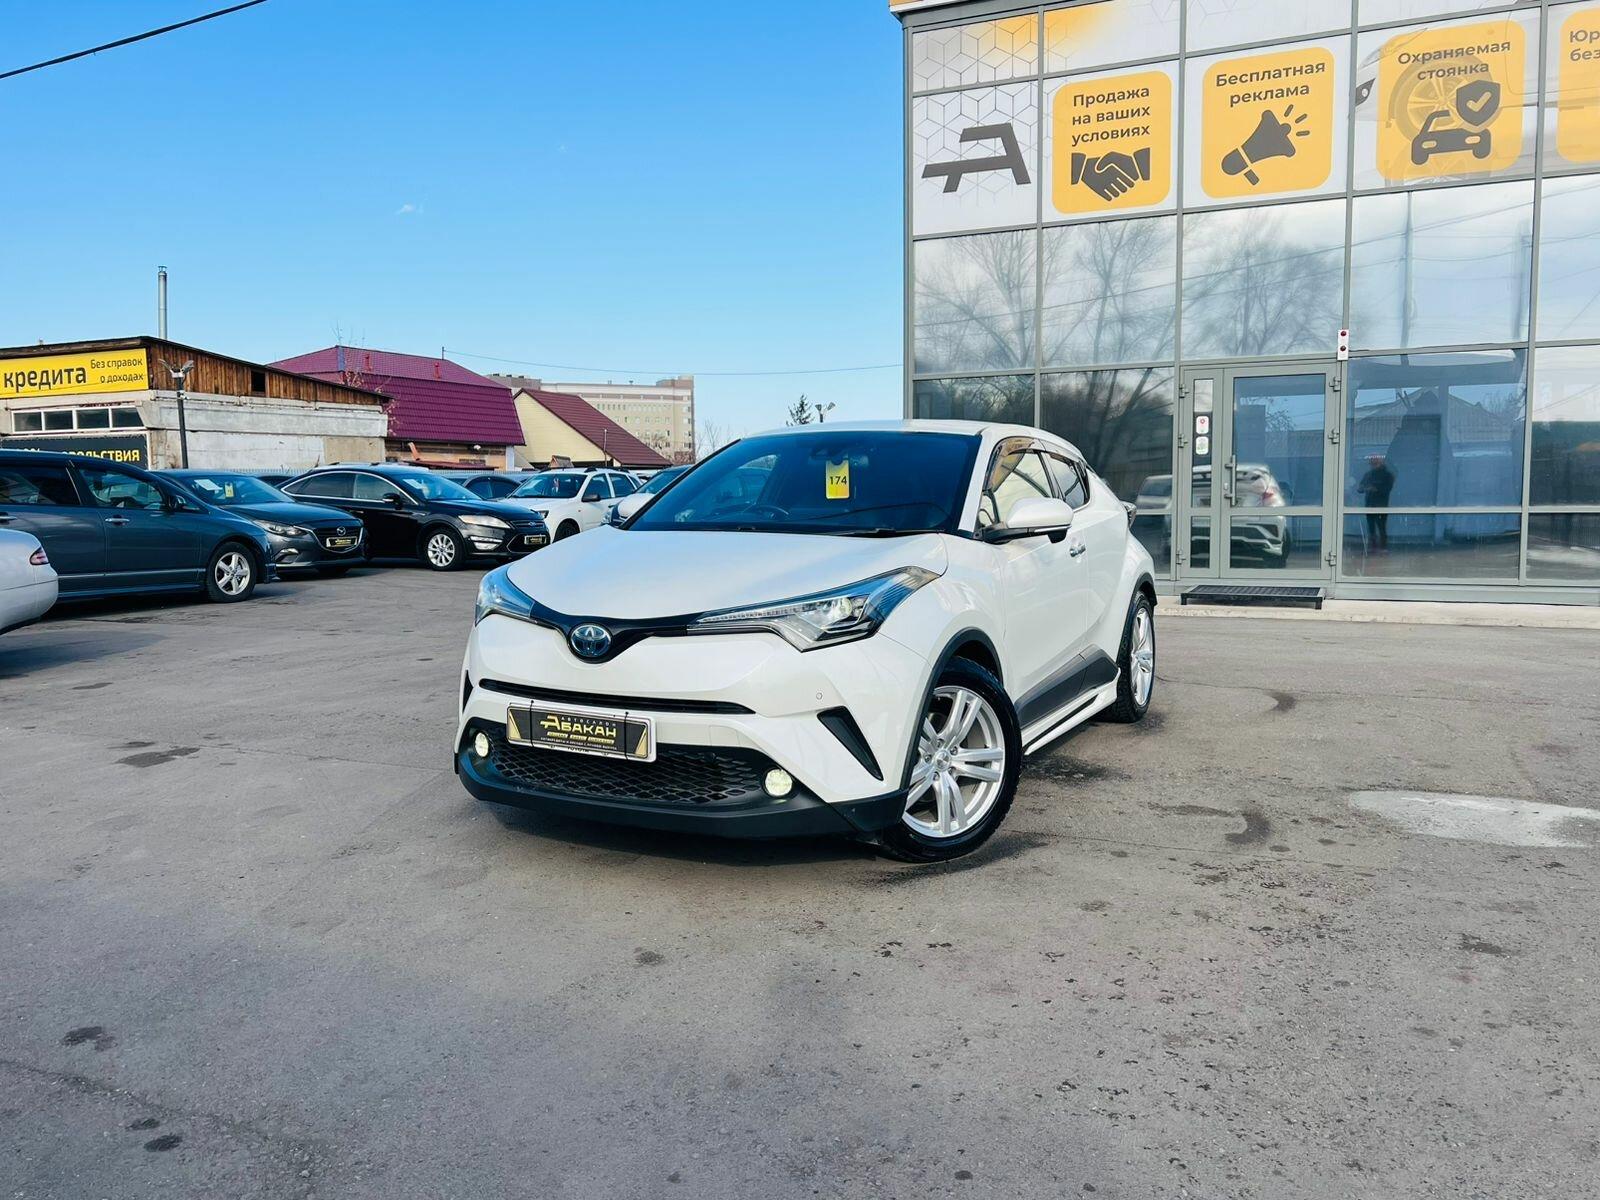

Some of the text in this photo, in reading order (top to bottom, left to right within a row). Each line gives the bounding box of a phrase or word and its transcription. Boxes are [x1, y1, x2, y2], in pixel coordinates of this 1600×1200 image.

[1569, 29, 1600, 44] Юр
[1397, 41, 1511, 65] Охраняемая
[1569, 48, 1600, 62] без
[1215, 62, 1326, 87] Бесплатная
[1417, 63, 1489, 81] стоянка
[1073, 87, 1150, 108] Продажа
[1230, 84, 1310, 108] реклама
[1072, 106, 1150, 126] на ваших
[1071, 125, 1151, 147] условиях
[90, 358, 143, 370] Без справок
[3, 366, 87, 393] кредита
[99, 373, 144, 384] о доходах
[829, 475, 848, 486] 174
